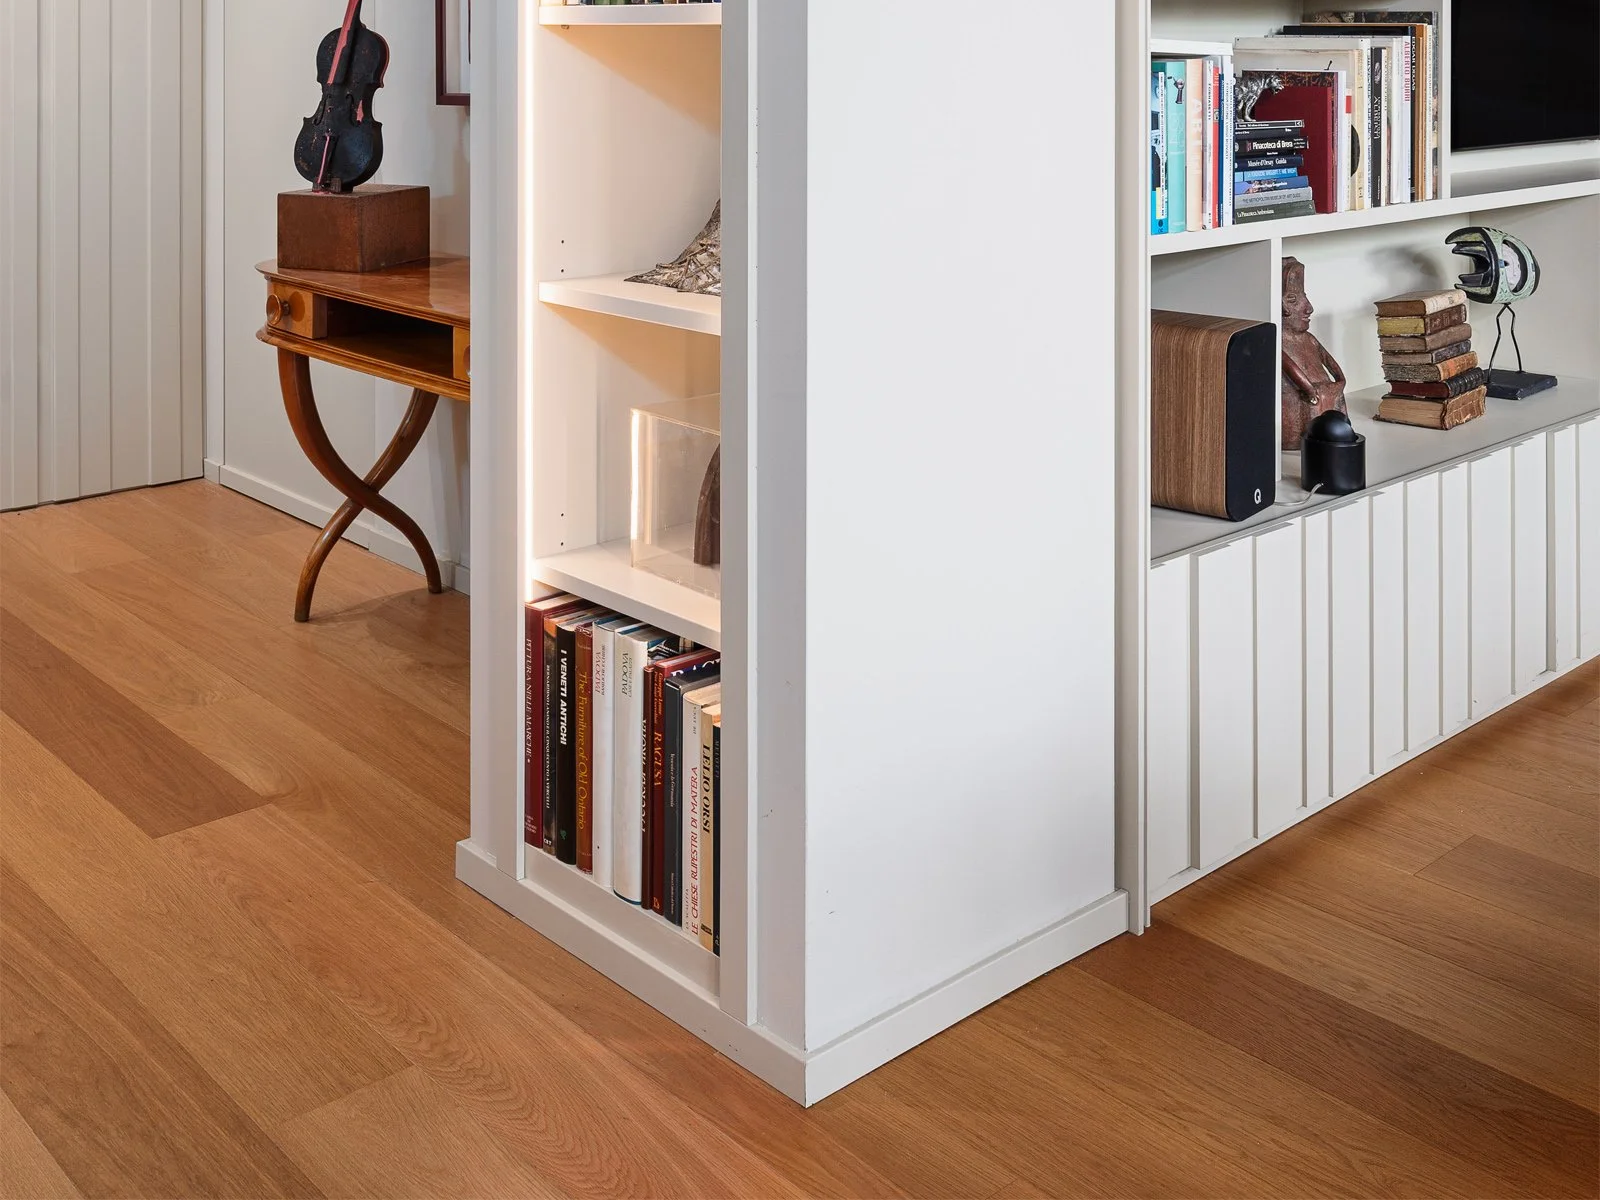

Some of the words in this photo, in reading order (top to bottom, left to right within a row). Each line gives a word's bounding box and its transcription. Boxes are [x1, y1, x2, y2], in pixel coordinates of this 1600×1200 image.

[1252, 141, 1277, 150] Pinacoteca
[1281, 140, 1293, 149] Brera
[525, 638, 533, 684] PITTURA
[560, 657, 568, 698] VENETI
[525, 685, 533, 718] NELLE
[578, 671, 588, 694] The
[525, 720, 533, 758] MARCHE
[560, 699, 568, 745] ANTICHI
[578, 695, 588, 745] Furniture
[578, 747, 588, 760] of
[653, 731, 664, 787] RAGUSA
[702, 742, 711, 793] LELIO
[578, 763, 588, 784] Old
[578, 786, 588, 830] Ontario
[691, 816, 698, 829] DI
[702, 795, 711, 834] ORSI
[691, 924, 698, 936] LE
